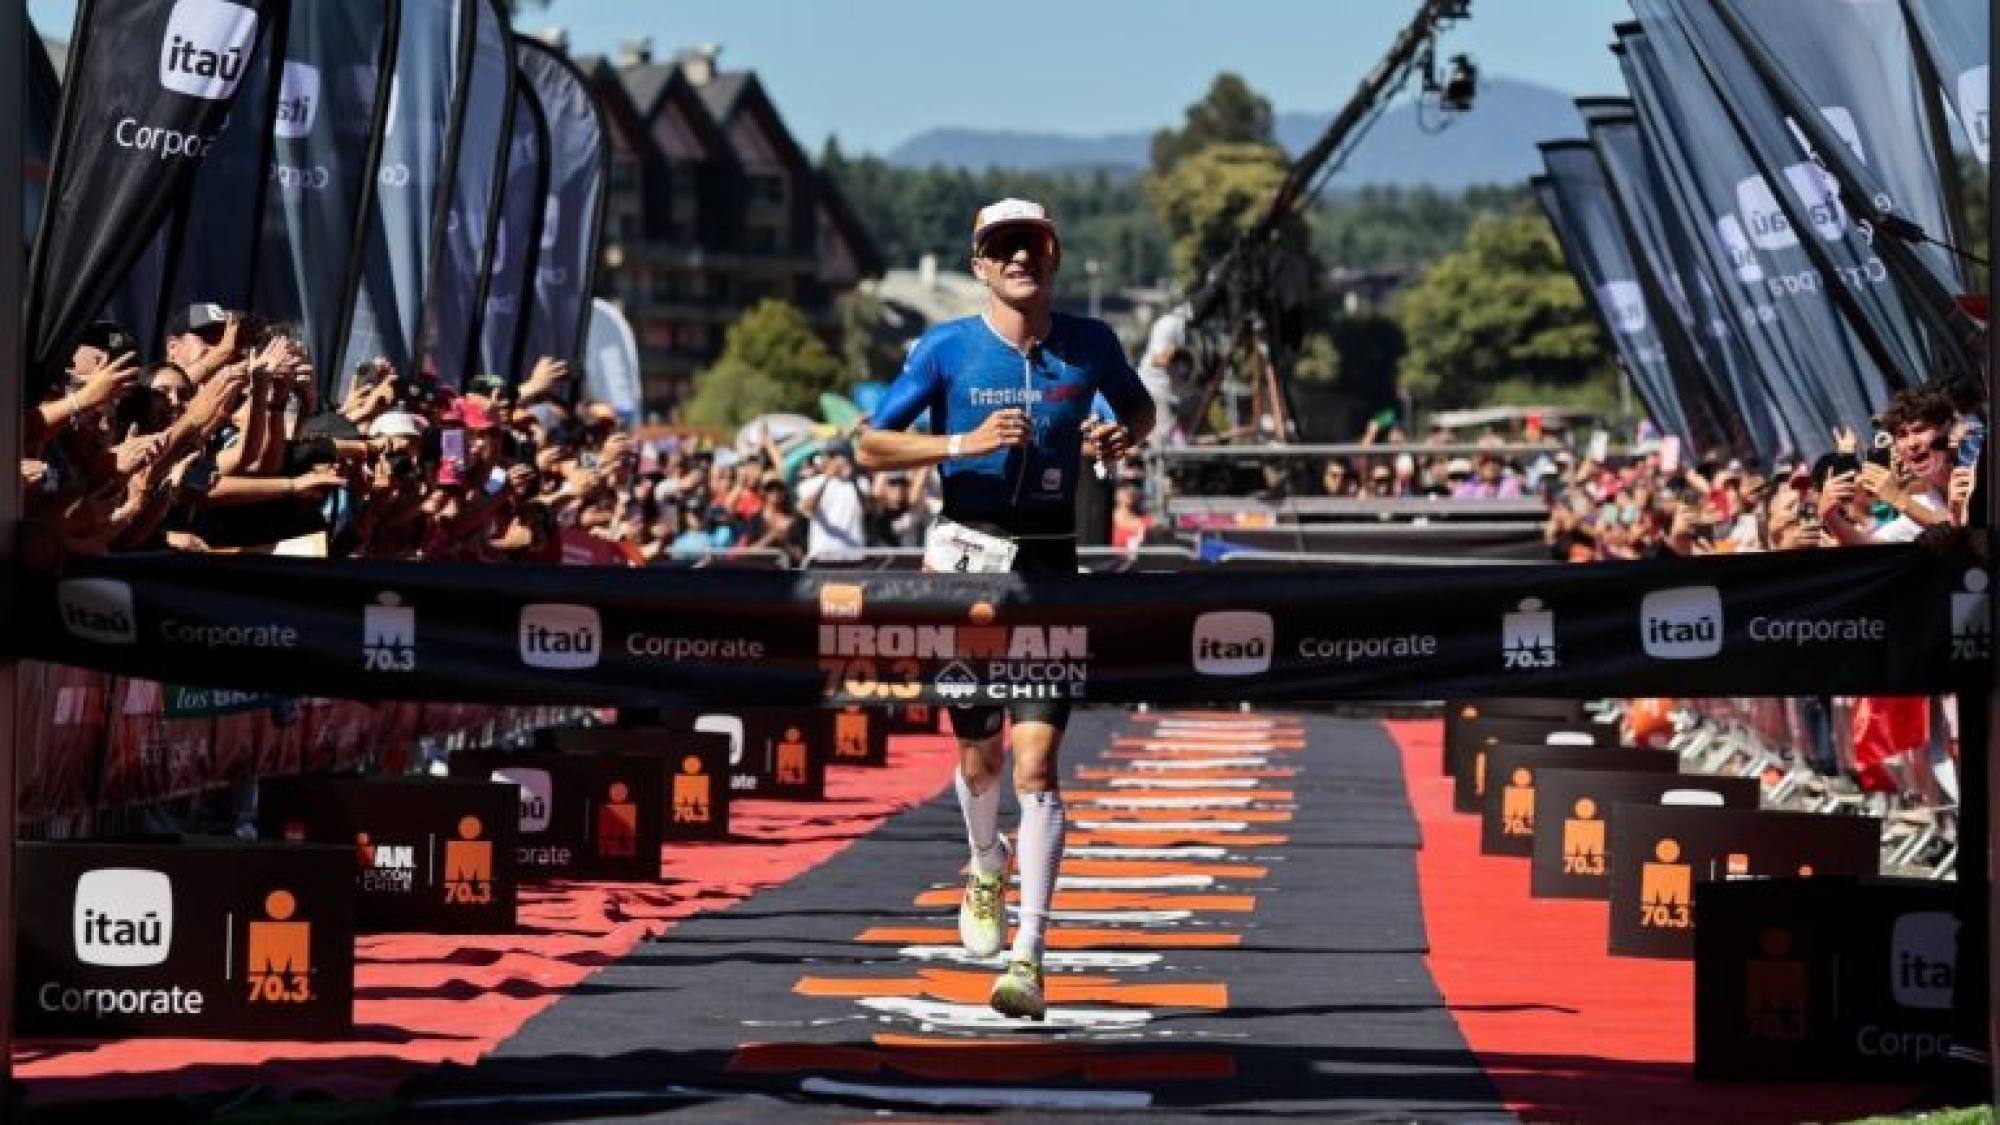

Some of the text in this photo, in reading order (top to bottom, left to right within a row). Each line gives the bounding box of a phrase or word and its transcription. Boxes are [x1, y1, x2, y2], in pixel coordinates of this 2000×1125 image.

[168, 34, 242, 82] itaú
[64, 604, 298, 649] itaú Corporate
[818, 625, 1088, 657] IRONMAN
[1648, 615, 1887, 647] itaú Corporate
[526, 624, 764, 666] itaú Corporate
[1199, 633, 1438, 662] itaú Corporate
[364, 649, 416, 671] 70.3
[988, 663, 1087, 681] PUCON
[1503, 651, 1557, 669] 70.3
[819, 658, 923, 697] 70.3
[987, 683, 1086, 699] CHILE
[1564, 856, 1606, 876] 70.3
[445, 881, 493, 904] 70.3
[84, 908, 162, 946] itaú
[1640, 904, 1690, 927] 70.3
[39, 982, 204, 1018] Corporate
[249, 974, 311, 1001] 70.3
